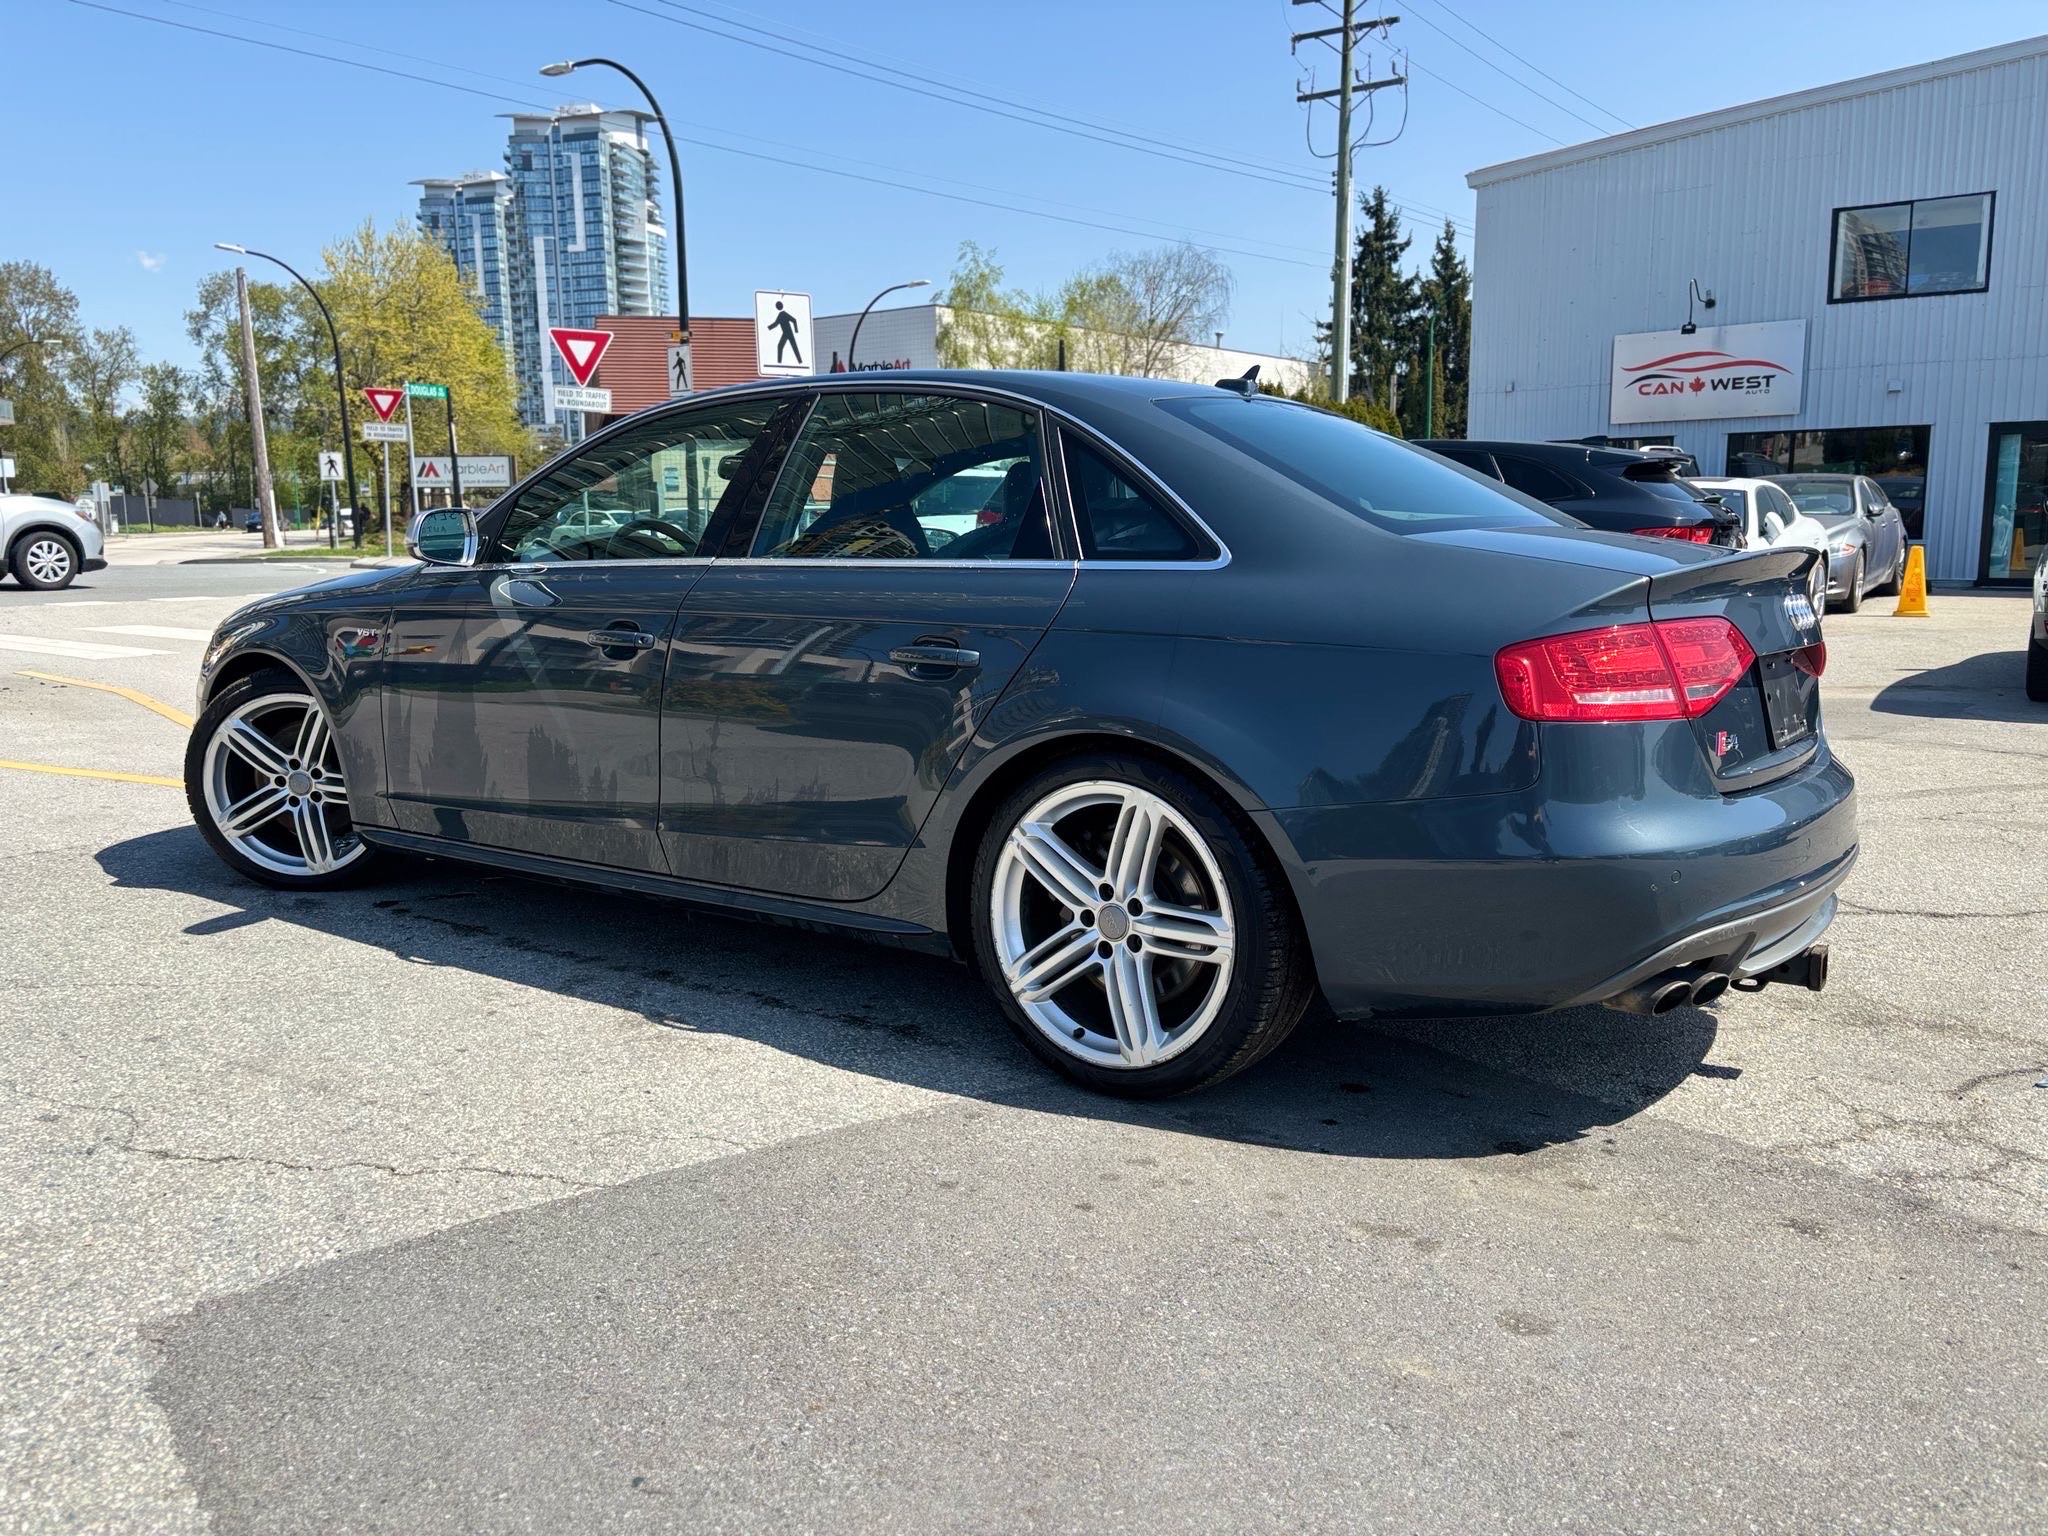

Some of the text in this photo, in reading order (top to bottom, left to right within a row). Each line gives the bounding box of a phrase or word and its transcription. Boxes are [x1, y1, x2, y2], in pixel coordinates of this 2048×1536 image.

[1638, 374, 1777, 396] CAN WEST
[410, 385, 437, 397] DOUGLAS
[557, 389, 608, 400] YIELD TO TRAFFIC
[567, 399, 607, 408] ROUNDABOUT
